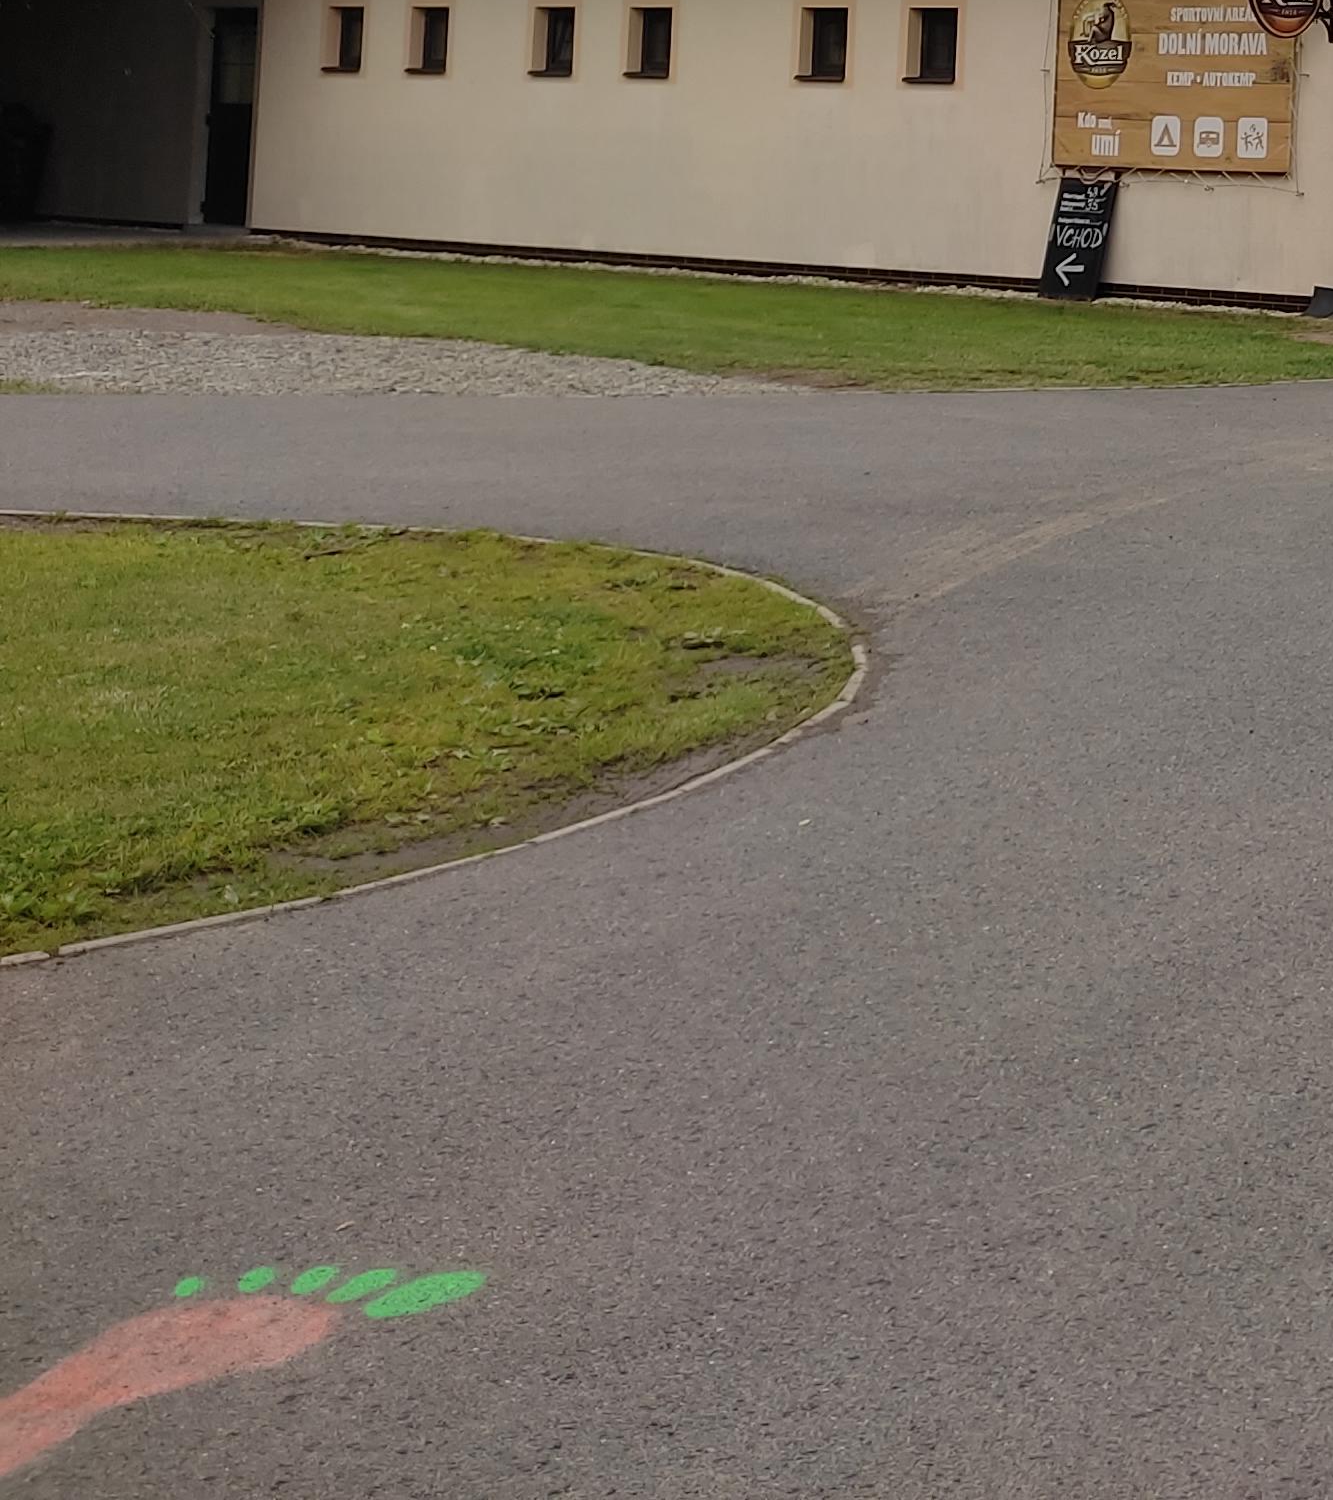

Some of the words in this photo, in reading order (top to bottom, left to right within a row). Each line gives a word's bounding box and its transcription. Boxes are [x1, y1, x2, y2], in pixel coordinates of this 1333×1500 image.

[1170, 3, 1224, 23] SPORTOVNÍ
[1158, 27, 1202, 56] DOLNÍ
[1204, 32, 1268, 56] MORAVA
[1074, 44, 1125, 66] Kozel
[1166, 71, 1195, 88] KEMP
[1202, 71, 1257, 88] AUTOKEMP
[1077, 111, 1097, 129] Kdo
[1091, 129, 1121, 157] umí
[1056, 224, 1103, 248] VCHOD
